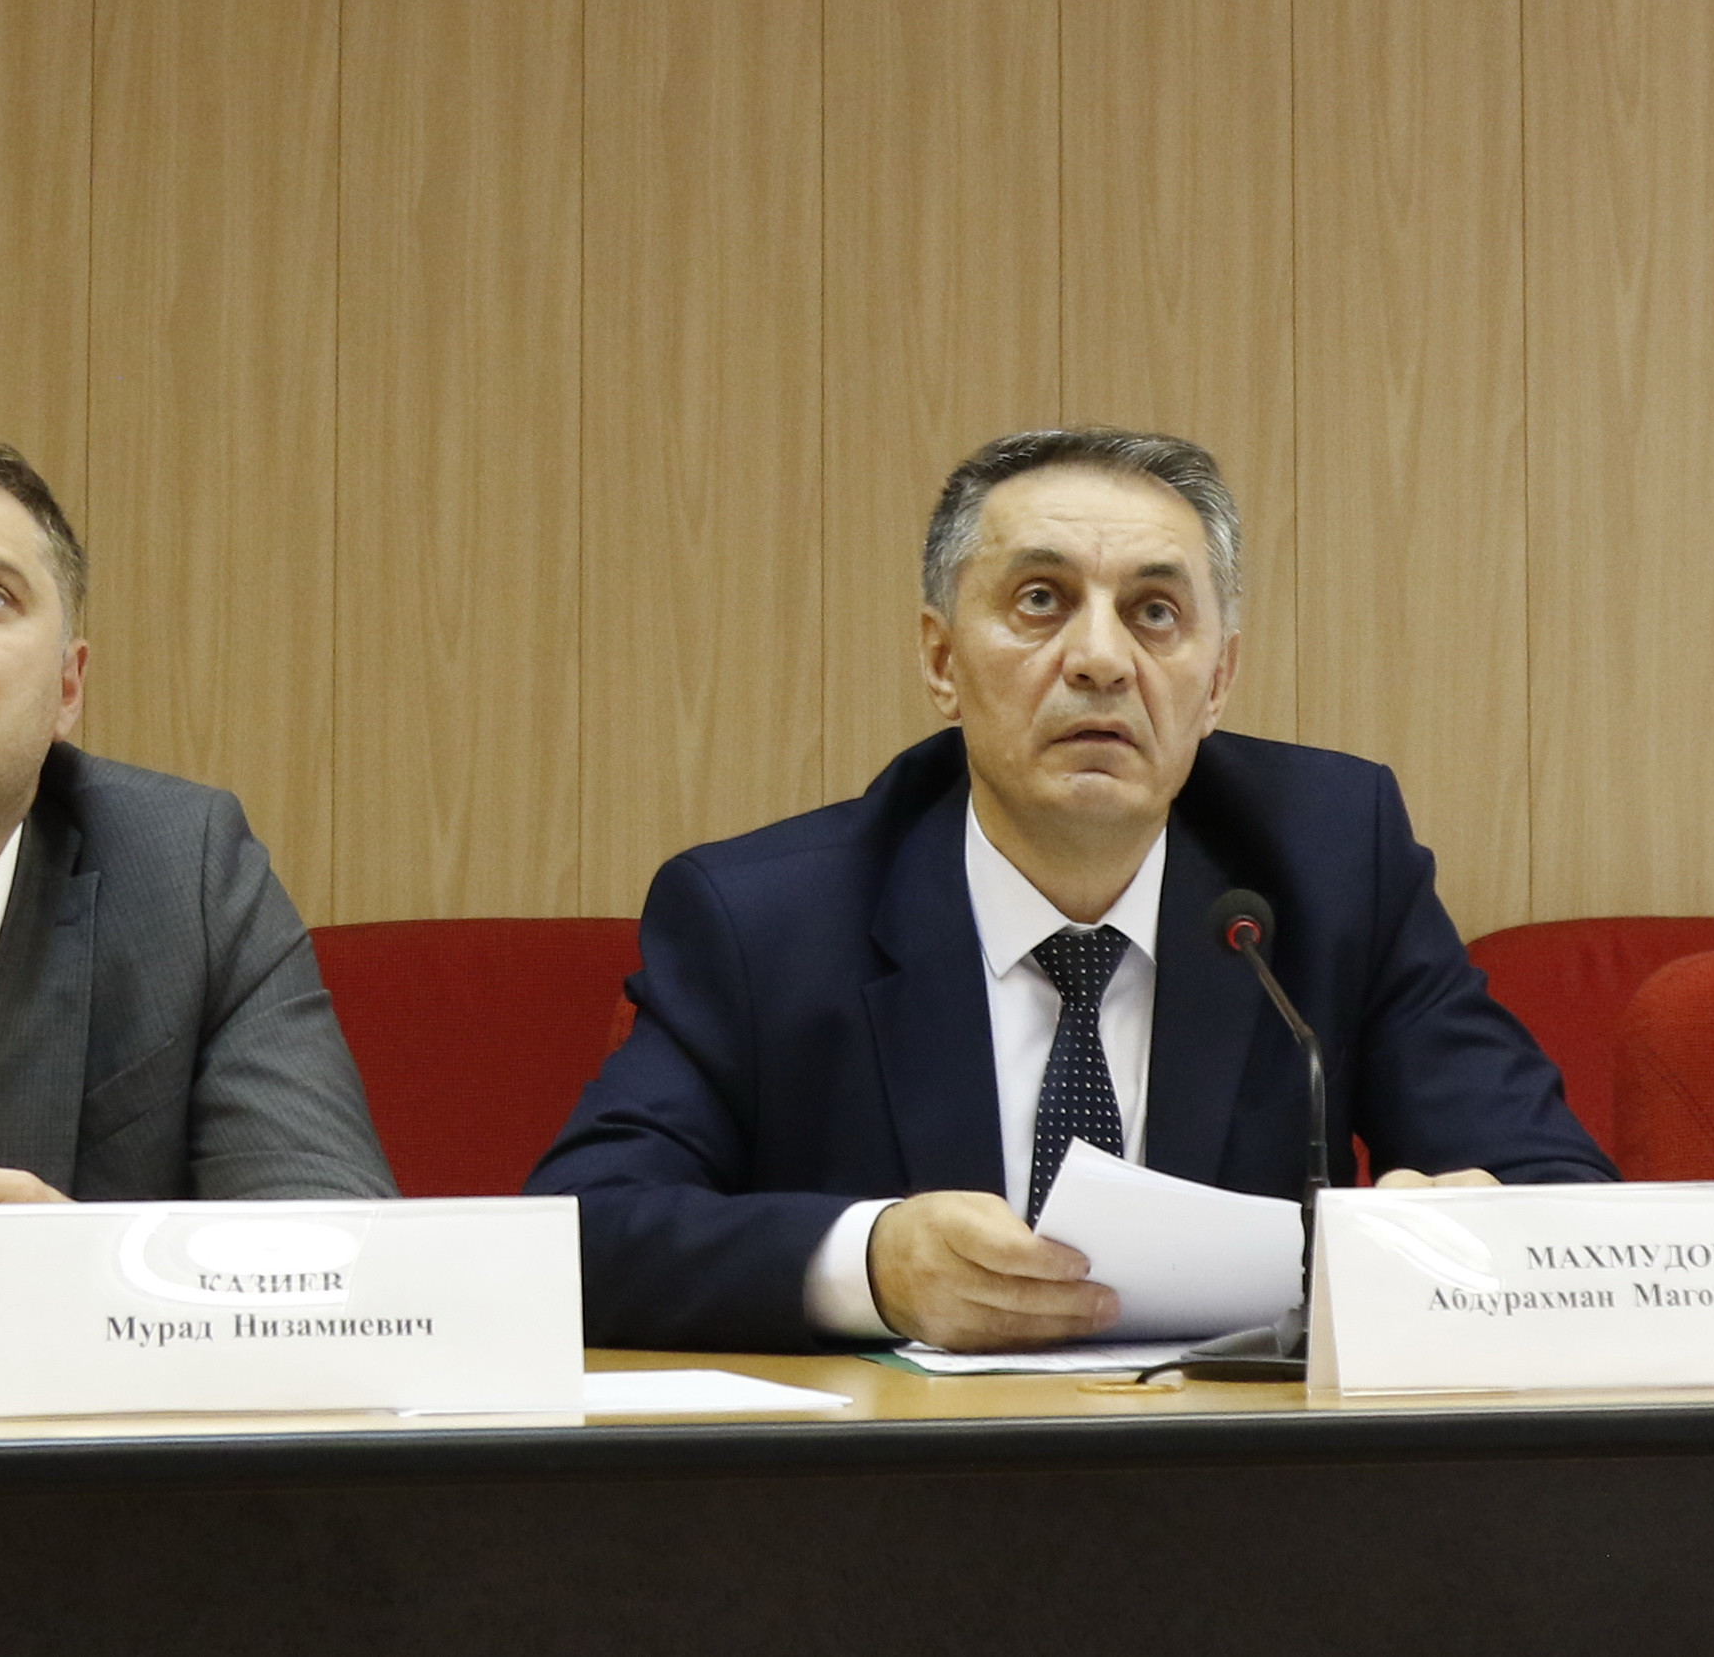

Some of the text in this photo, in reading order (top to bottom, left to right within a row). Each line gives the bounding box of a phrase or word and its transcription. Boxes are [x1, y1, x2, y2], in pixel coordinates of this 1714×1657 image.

[1429, 1285, 1615, 1316] Абдурахман
[105, 1312, 435, 1348] Мурад Низамиевич
